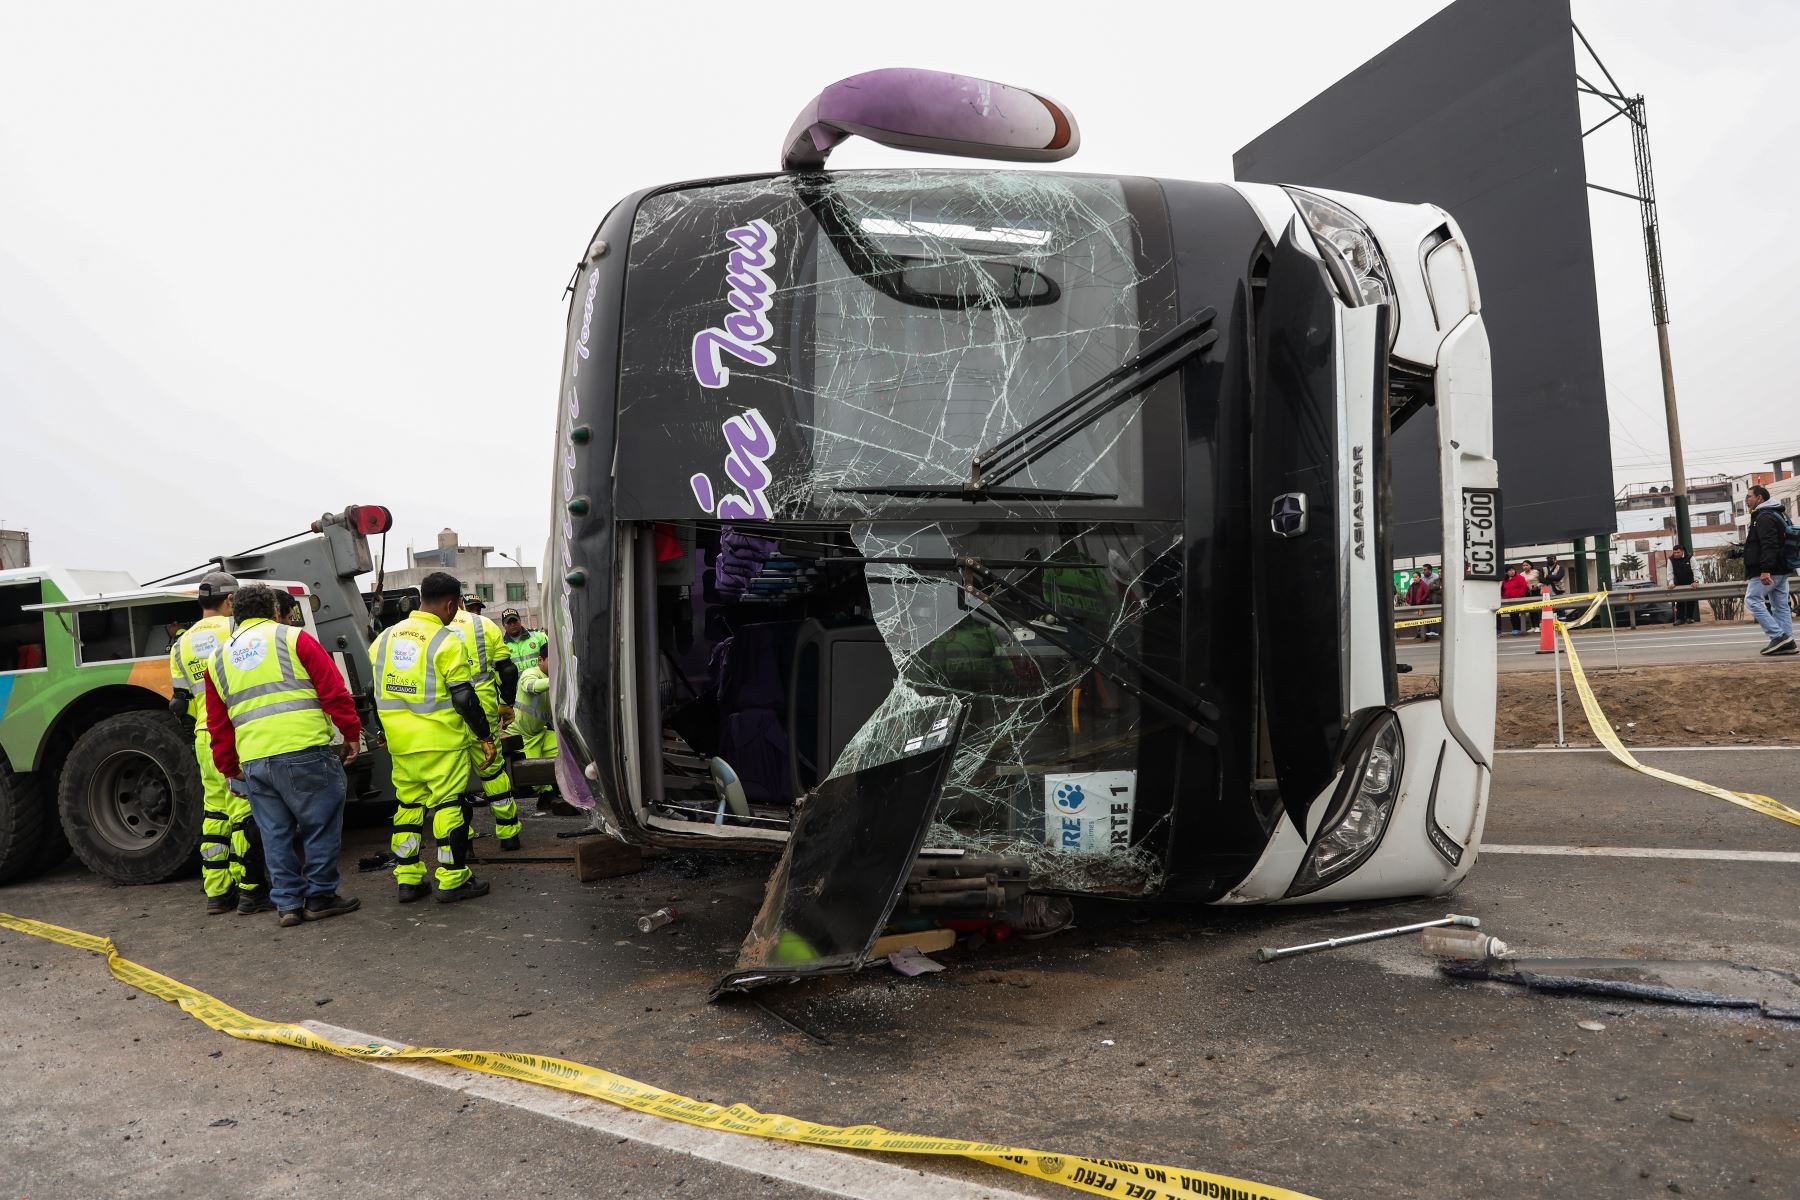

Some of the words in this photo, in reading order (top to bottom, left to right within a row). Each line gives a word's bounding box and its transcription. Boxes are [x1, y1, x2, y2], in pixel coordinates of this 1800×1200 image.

[692, 218, 777, 388] Tours
[1353, 444, 1365, 560] ASIASTAR
[1470, 493, 1495, 575] CCI-600
[386, 685, 416, 694] ASOCIADOS
[1109, 787, 1128, 796] 1
[1067, 1168, 1118, 1191] PERÚ"
[1144, 1168, 1167, 1184] NO
